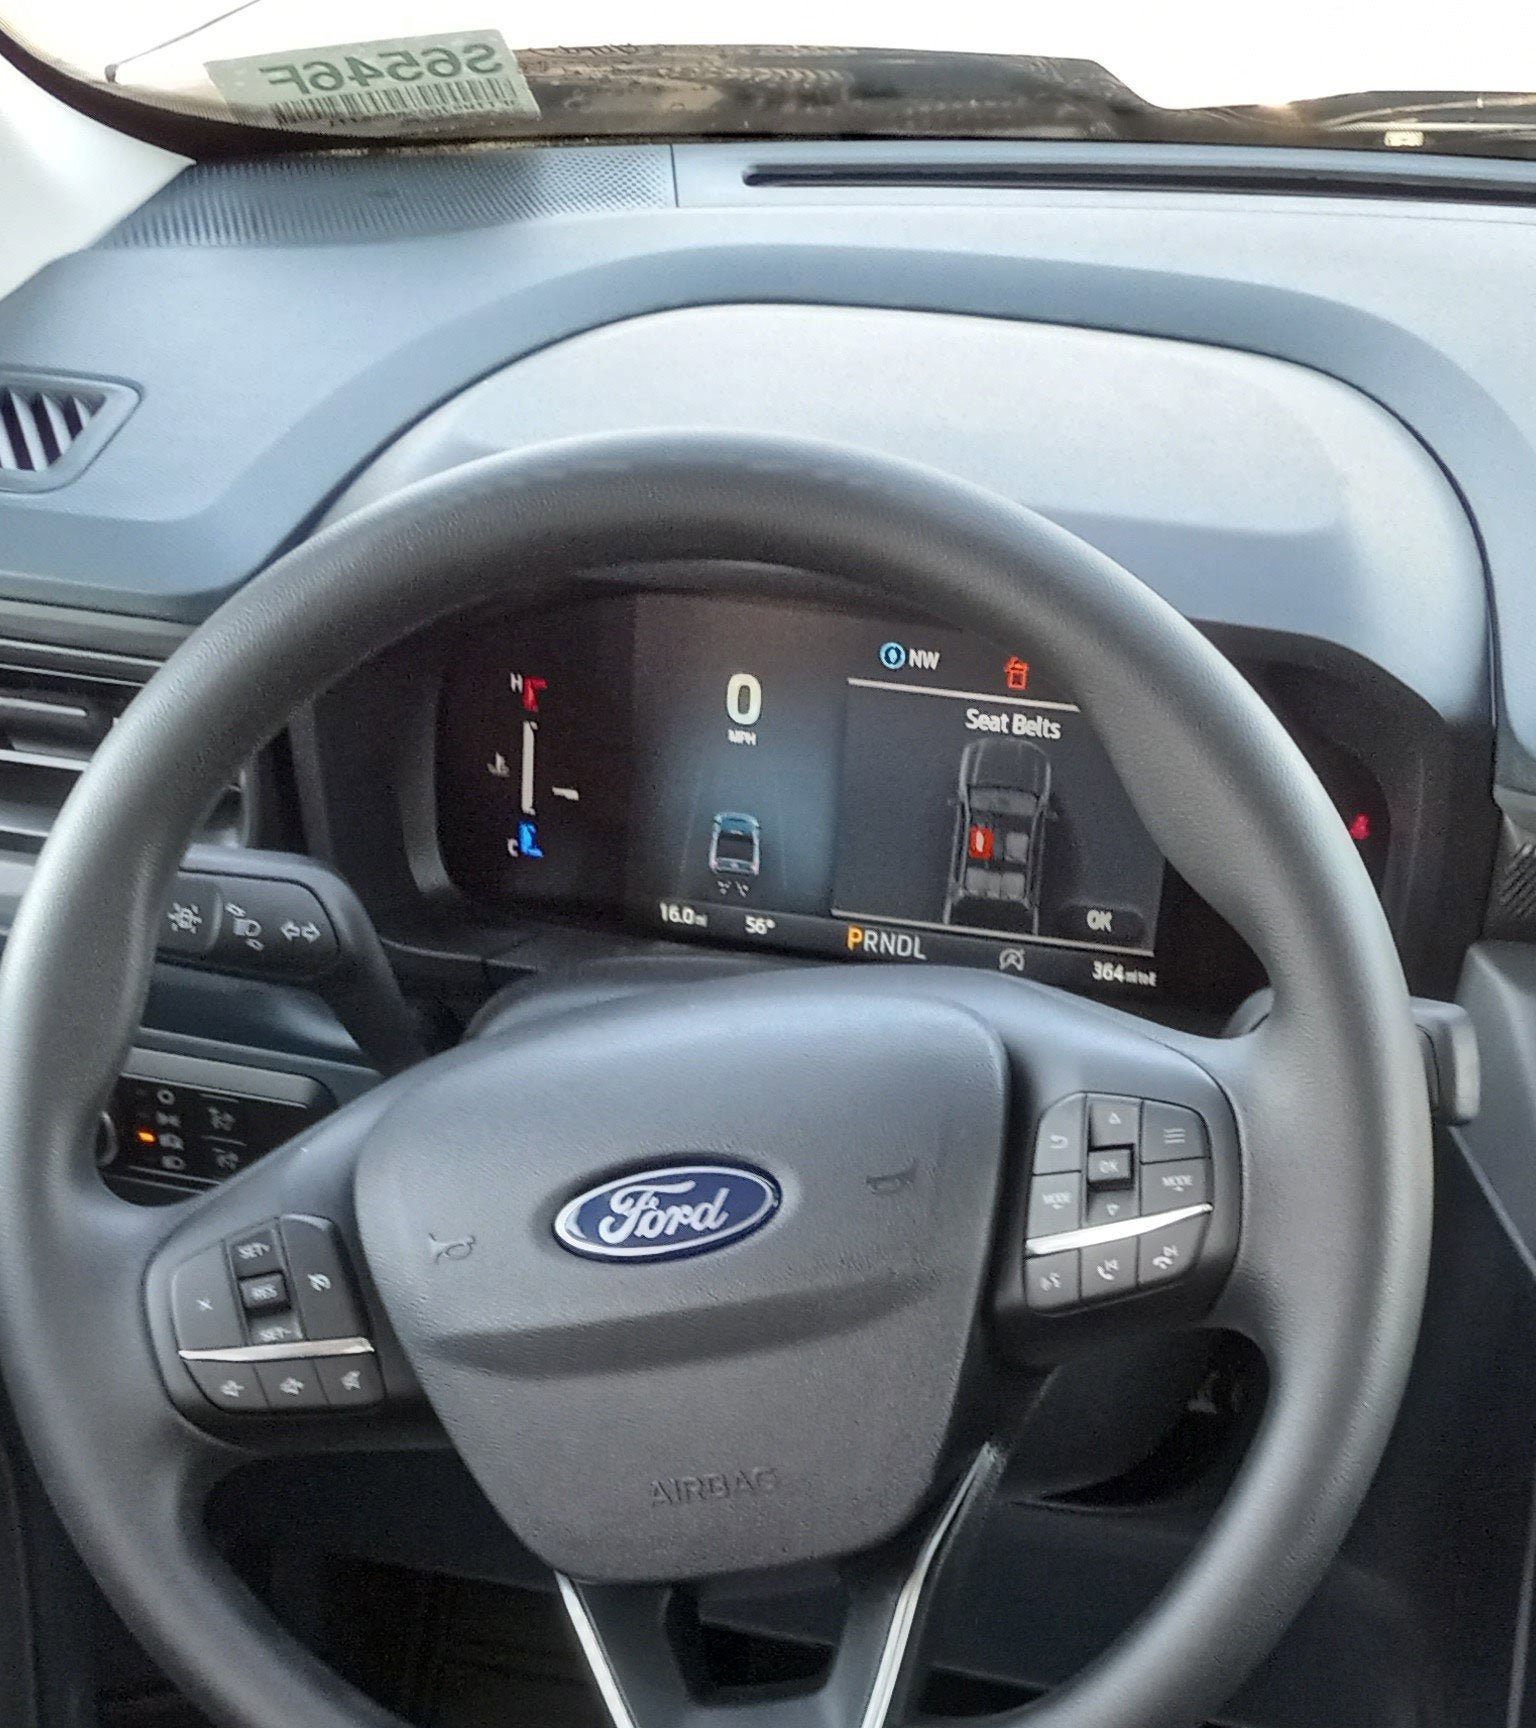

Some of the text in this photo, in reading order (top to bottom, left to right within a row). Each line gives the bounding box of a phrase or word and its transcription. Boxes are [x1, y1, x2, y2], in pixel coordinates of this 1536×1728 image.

[908, 648, 940, 670] NW
[726, 673, 762, 725] 0
[966, 708, 1062, 740] Seat Belts
[1086, 909, 1113, 932] OK
[598, 1179, 731, 1244] Ford
[651, 1468, 778, 1507] AIRBAG
